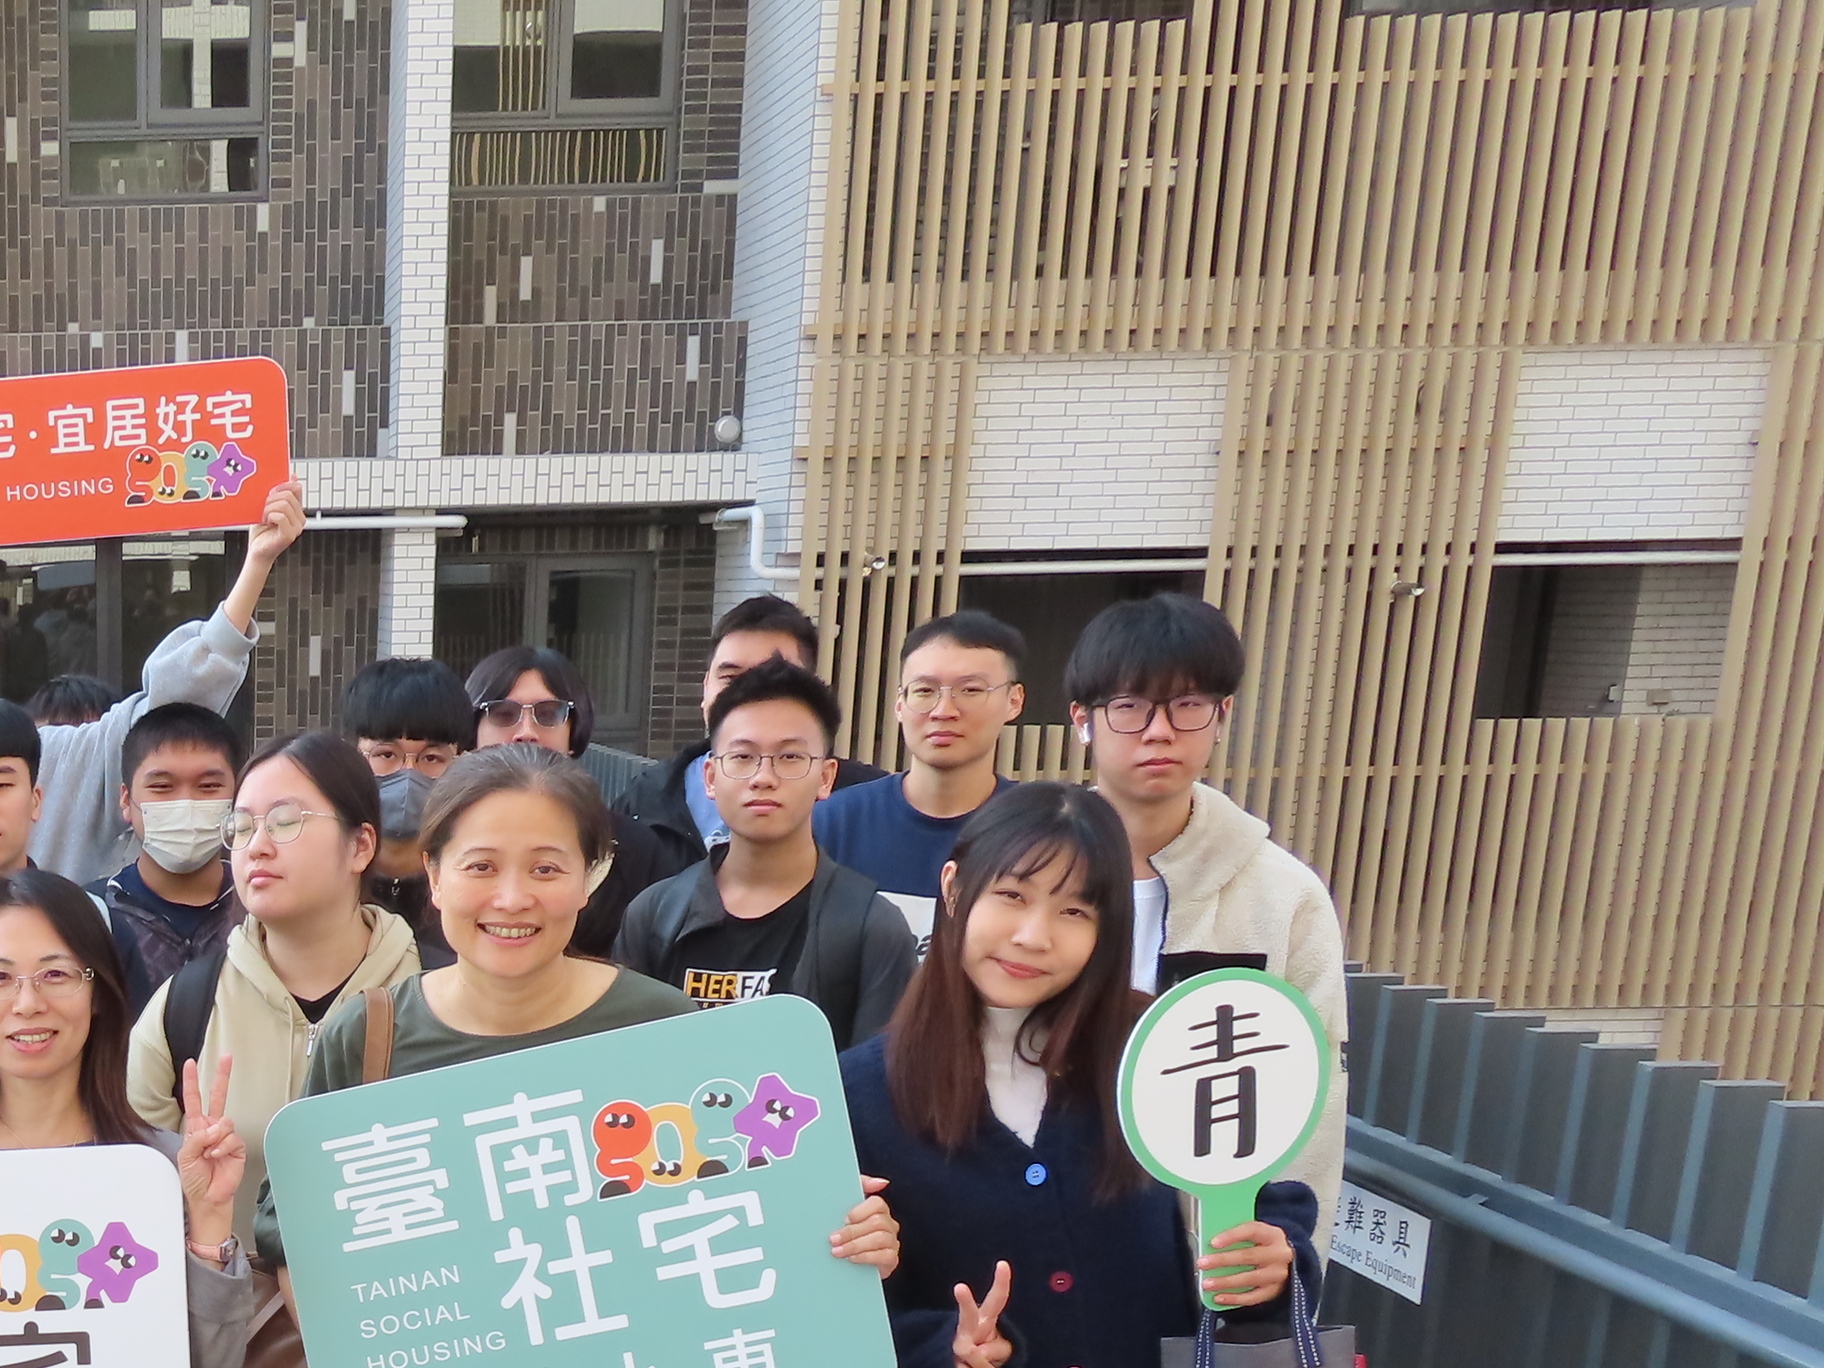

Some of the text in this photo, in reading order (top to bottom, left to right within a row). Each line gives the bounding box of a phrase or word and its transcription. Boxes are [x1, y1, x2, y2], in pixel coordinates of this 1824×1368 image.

[6, 477, 115, 502] HOUSING
[1160, 1003, 1290, 1159] 青
[321, 1089, 598, 1253] 臺南
[350, 1265, 461, 1304] TAINAN
[492, 1189, 777, 1347] 社宅
[1330, 1234, 1417, 1289] Escape Equipment
[359, 1301, 471, 1339] SOCIAL
